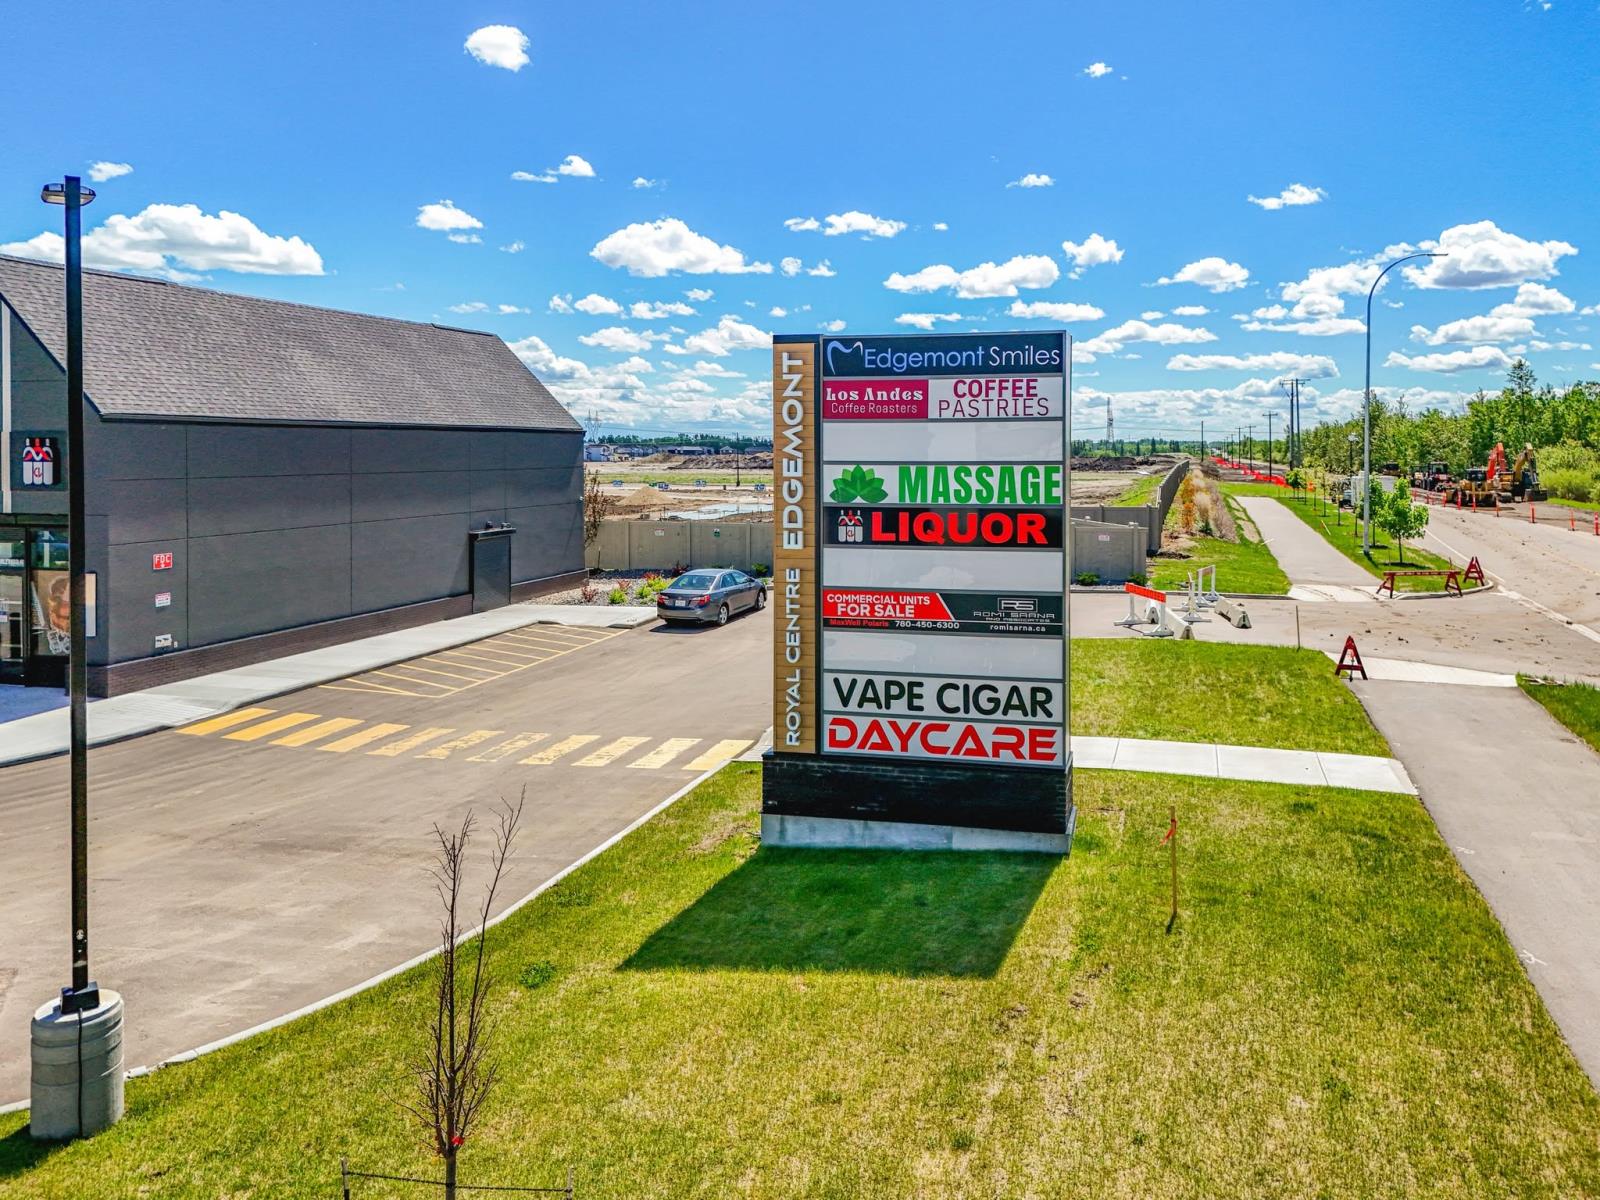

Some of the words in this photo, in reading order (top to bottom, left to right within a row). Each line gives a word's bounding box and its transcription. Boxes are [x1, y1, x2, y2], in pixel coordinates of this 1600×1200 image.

[864, 346, 984, 373] Edgemont
[989, 346, 1060, 367] Smiles
[826, 388, 859, 401] Los
[864, 388, 924, 401] Andes
[953, 379, 1038, 398] COFFEE
[831, 403, 866, 414] Coffee
[868, 402, 918, 414] Roasters
[938, 398, 1049, 418] PASTRIES
[782, 352, 804, 550] EDGEMONT
[898, 465, 1061, 505] MASSAGE
[871, 511, 1048, 545] LIQUOR
[155, 554, 171, 564] FDC
[826, 593, 897, 605] COMMERCIAL
[899, 595, 931, 606] UNITS
[785, 568, 801, 664] CENTRE
[837, 603, 871, 617] FOR
[874, 604, 915, 618] SALE
[895, 620, 960, 629] 780-450-6300
[990, 623, 1046, 632] romisarna.ca
[785, 669, 801, 747] ROYAL
[832, 677, 925, 712] VAPE
[936, 682, 1054, 719] CIGAR
[828, 717, 1058, 762] DAYCARE
